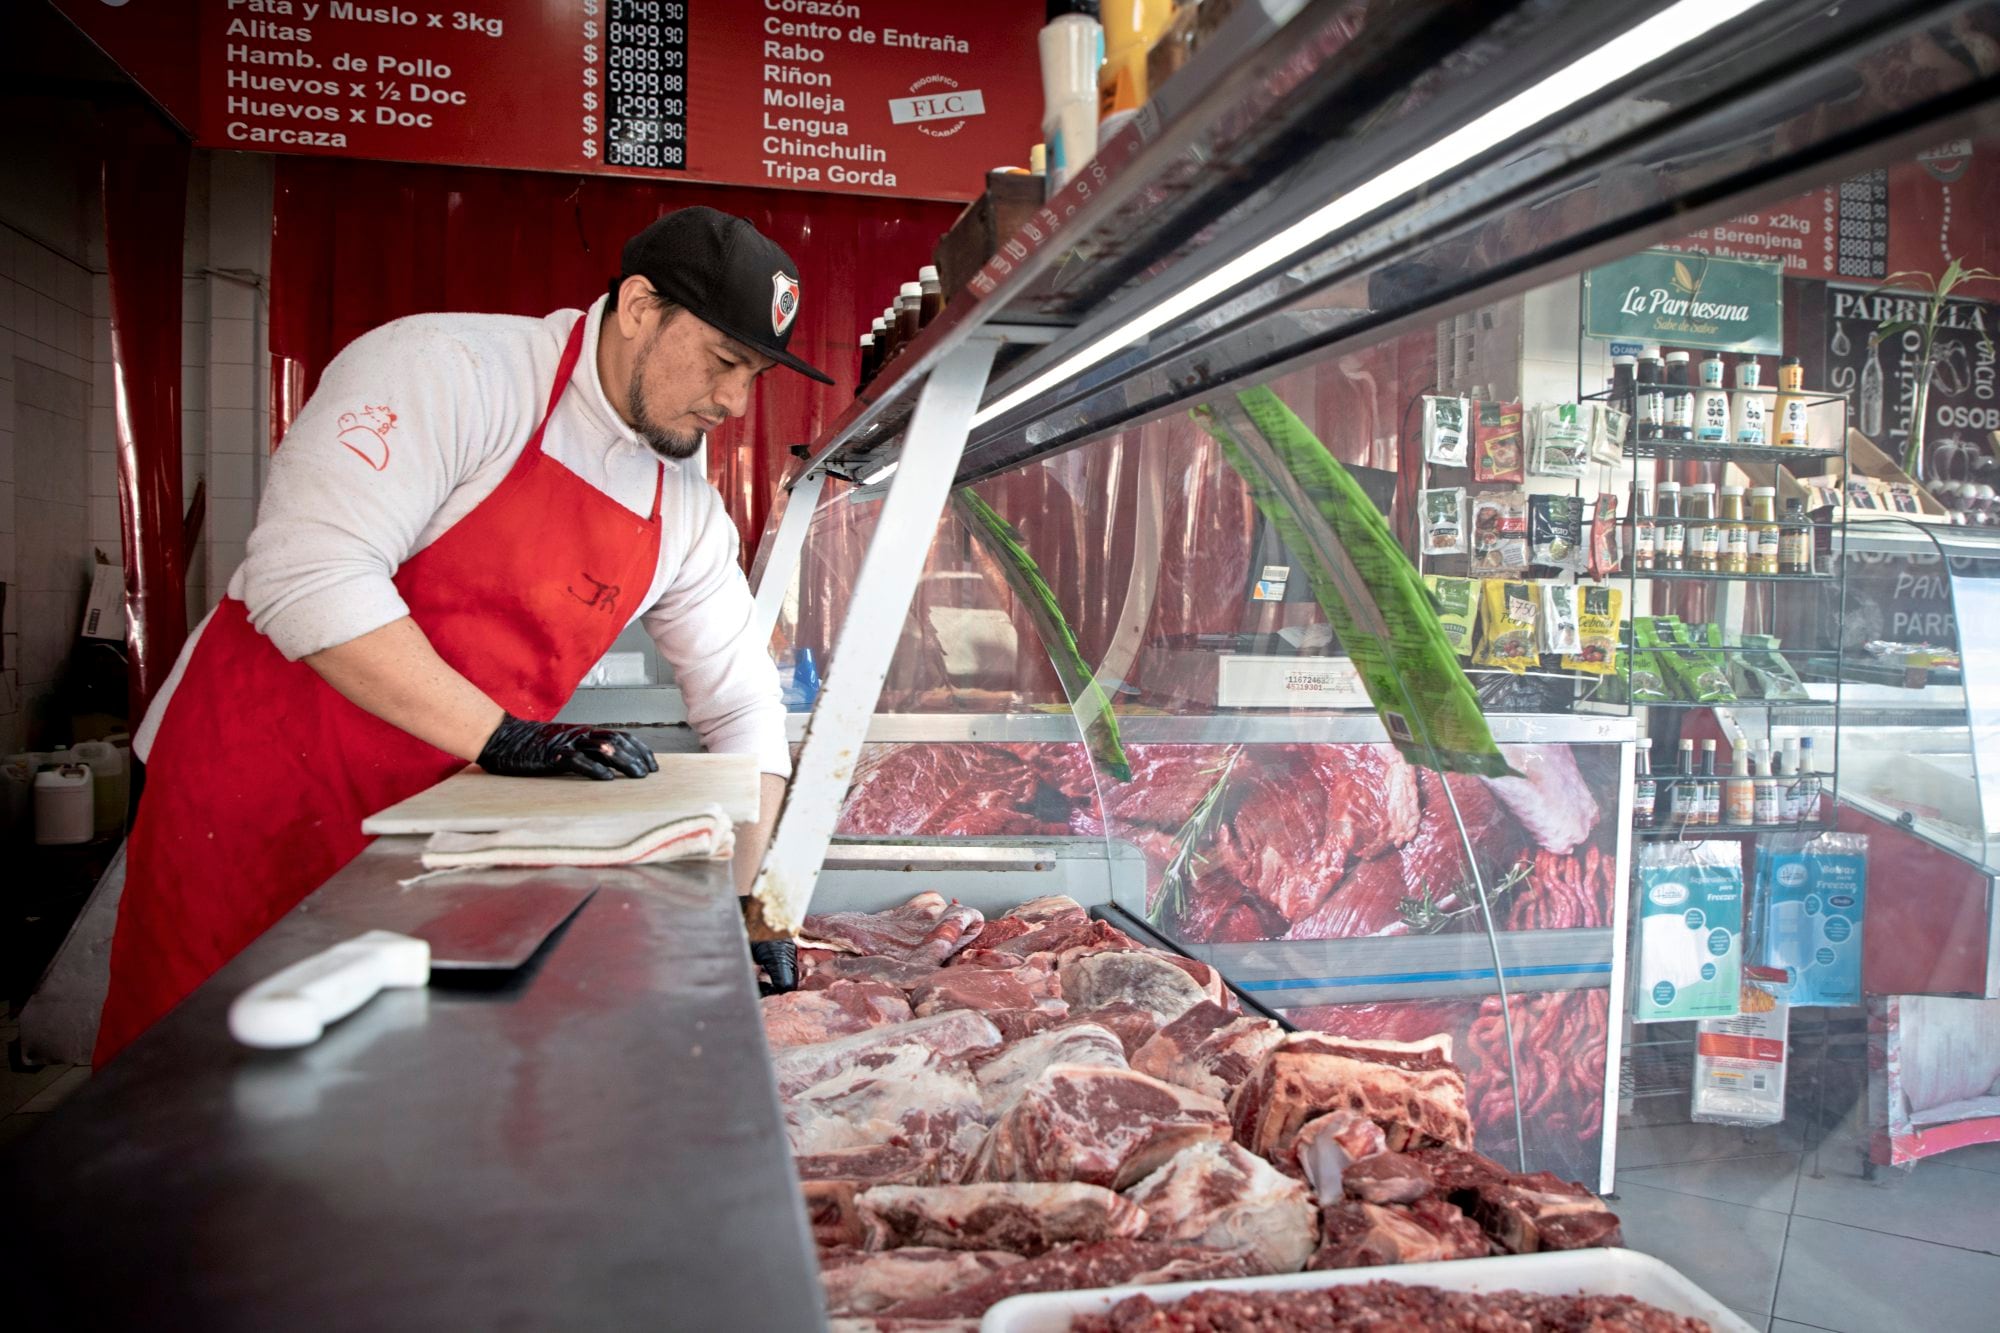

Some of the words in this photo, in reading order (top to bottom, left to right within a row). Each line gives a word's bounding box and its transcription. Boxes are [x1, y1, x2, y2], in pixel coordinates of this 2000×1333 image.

[226, 18, 312, 42] Alitas
[303, 3, 320, 20] y
[330, 1, 418, 26] Muslo
[426, 13, 443, 28] x
[452, 11, 503, 37] 3kg
[610, 22, 683, 46] 8499.90
[764, 17, 842, 40] Centro
[848, 26, 876, 44] de
[883, 28, 969, 53] Entraña
[227, 43, 322, 69] Hamb.
[332, 53, 368, 72] de
[378, 55, 452, 78] Pollo
[610, 46, 683, 70] 2899.90
[764, 40, 824, 62] Rabo
[227, 69, 340, 96] Huevos
[349, 83, 367, 98] x
[410, 83, 467, 105] Doc
[610, 70, 683, 94] 5999.88
[764, 64, 831, 87] Riñon
[227, 95, 340, 122] Huevos
[349, 108, 367, 124] x
[376, 106, 433, 128] Doc
[617, 95, 683, 118] 1299.90
[764, 88, 845, 115] Molleja
[911, 95, 965, 117] FLC
[226, 121, 347, 148] Carcaza
[764, 112, 849, 138] Lengua
[763, 136, 886, 162] Chinchulin
[762, 160, 820, 184] Tripa
[827, 165, 897, 187] Gorda
[1769, 214, 1811, 235] x2kg
[1714, 227, 1803, 250] Berenjena
[1620, 286, 1647, 316] La
[1648, 288, 1750, 322] Parmesana
